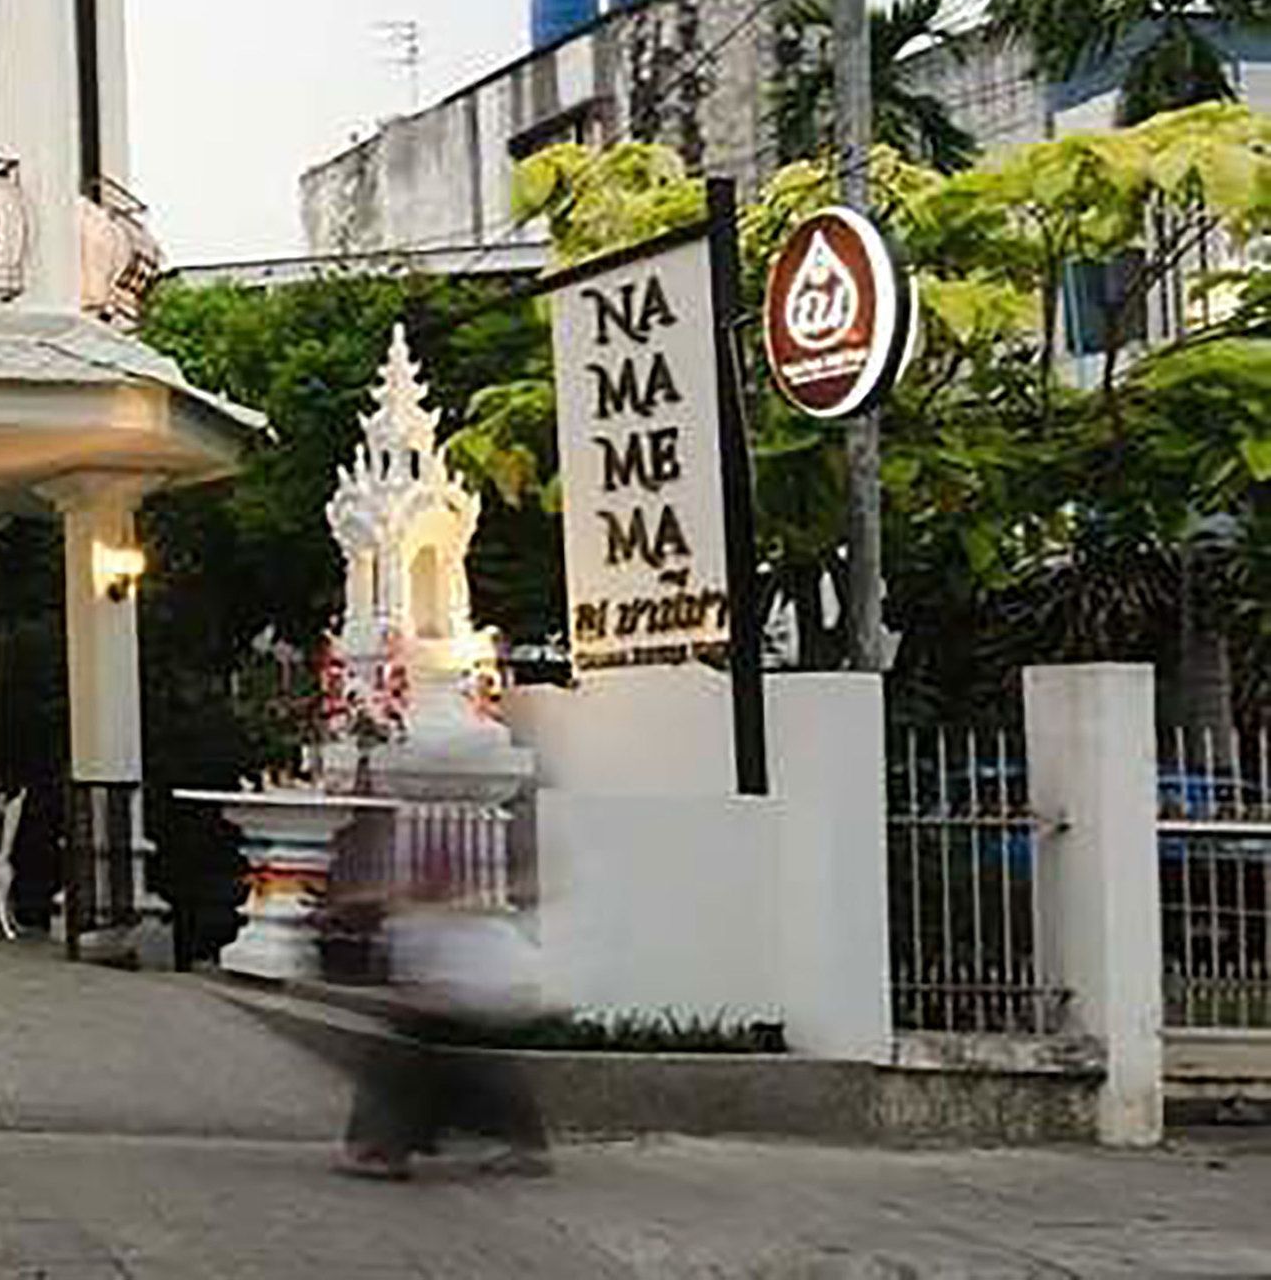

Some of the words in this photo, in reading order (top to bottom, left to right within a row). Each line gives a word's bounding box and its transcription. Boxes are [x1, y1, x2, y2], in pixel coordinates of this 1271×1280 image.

[580, 275, 679, 345] NA
[584, 351, 683, 419] MA
[591, 426, 681, 492] ME
[595, 504, 693, 568] MA
